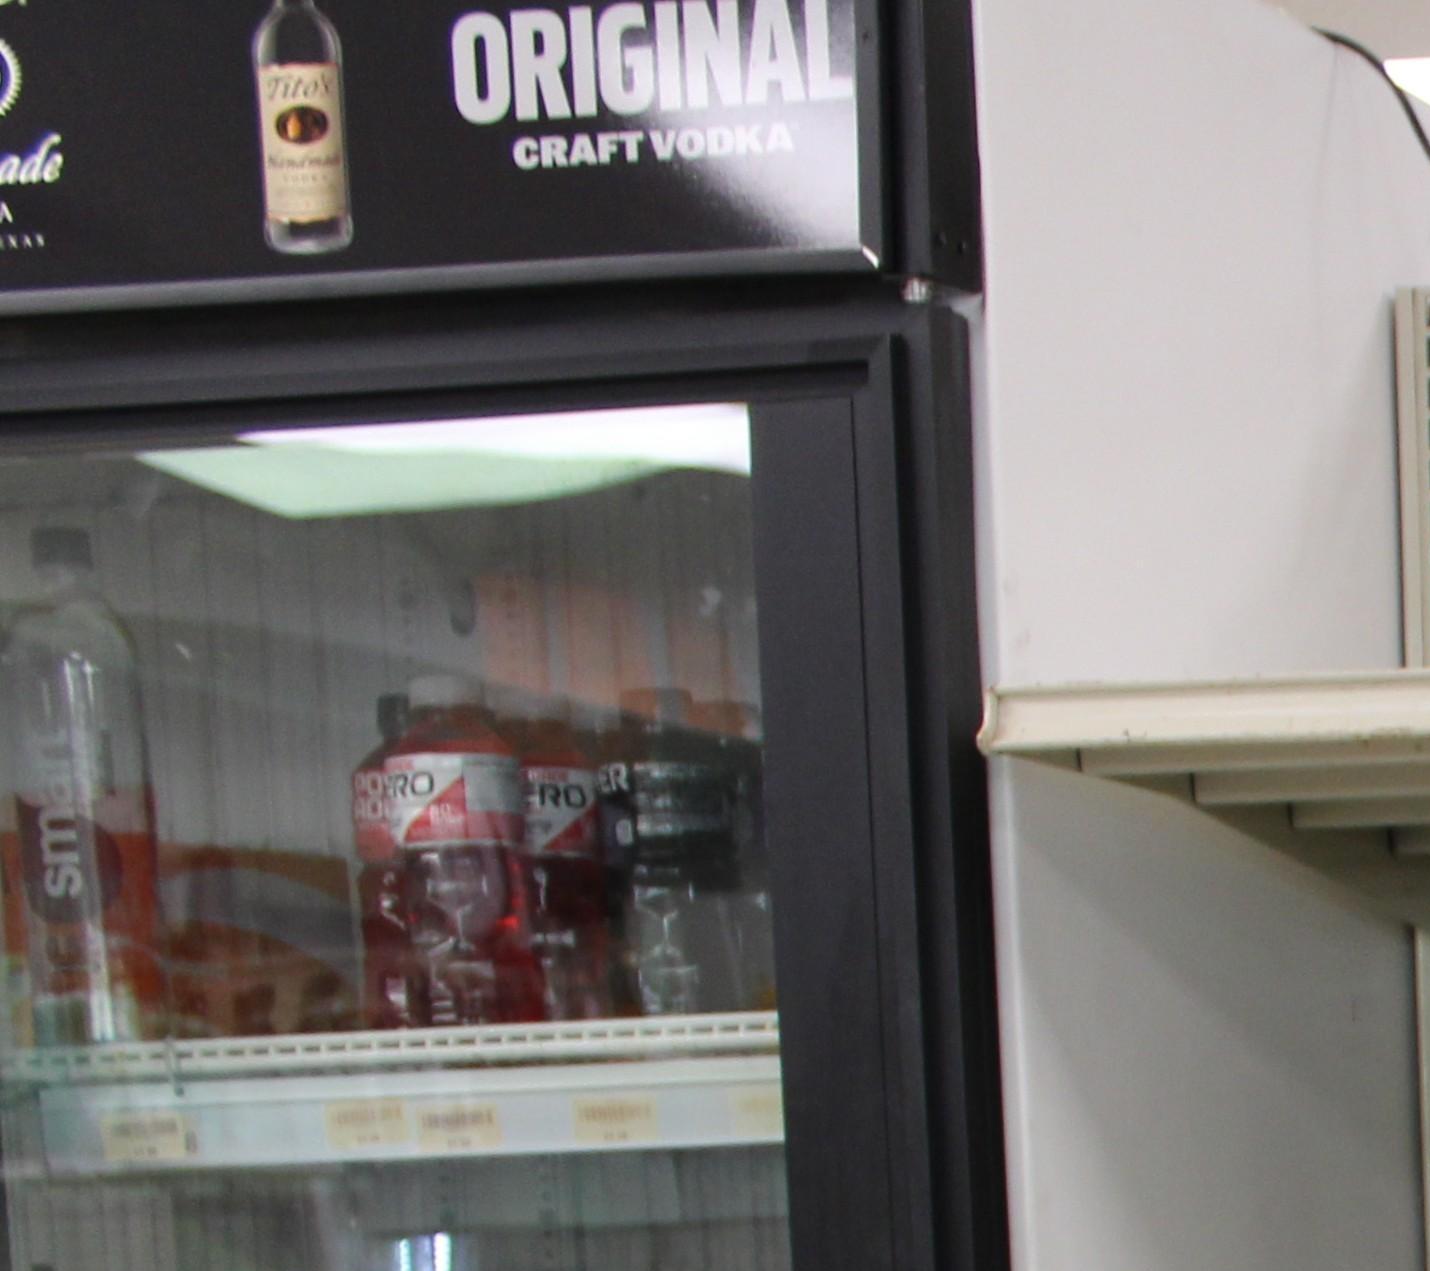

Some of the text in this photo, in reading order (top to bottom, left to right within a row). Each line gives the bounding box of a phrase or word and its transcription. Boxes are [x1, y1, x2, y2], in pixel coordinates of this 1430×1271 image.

[451, 0, 857, 125] ORIGINAL
[512, 121, 796, 170] CRAFT VODKA
